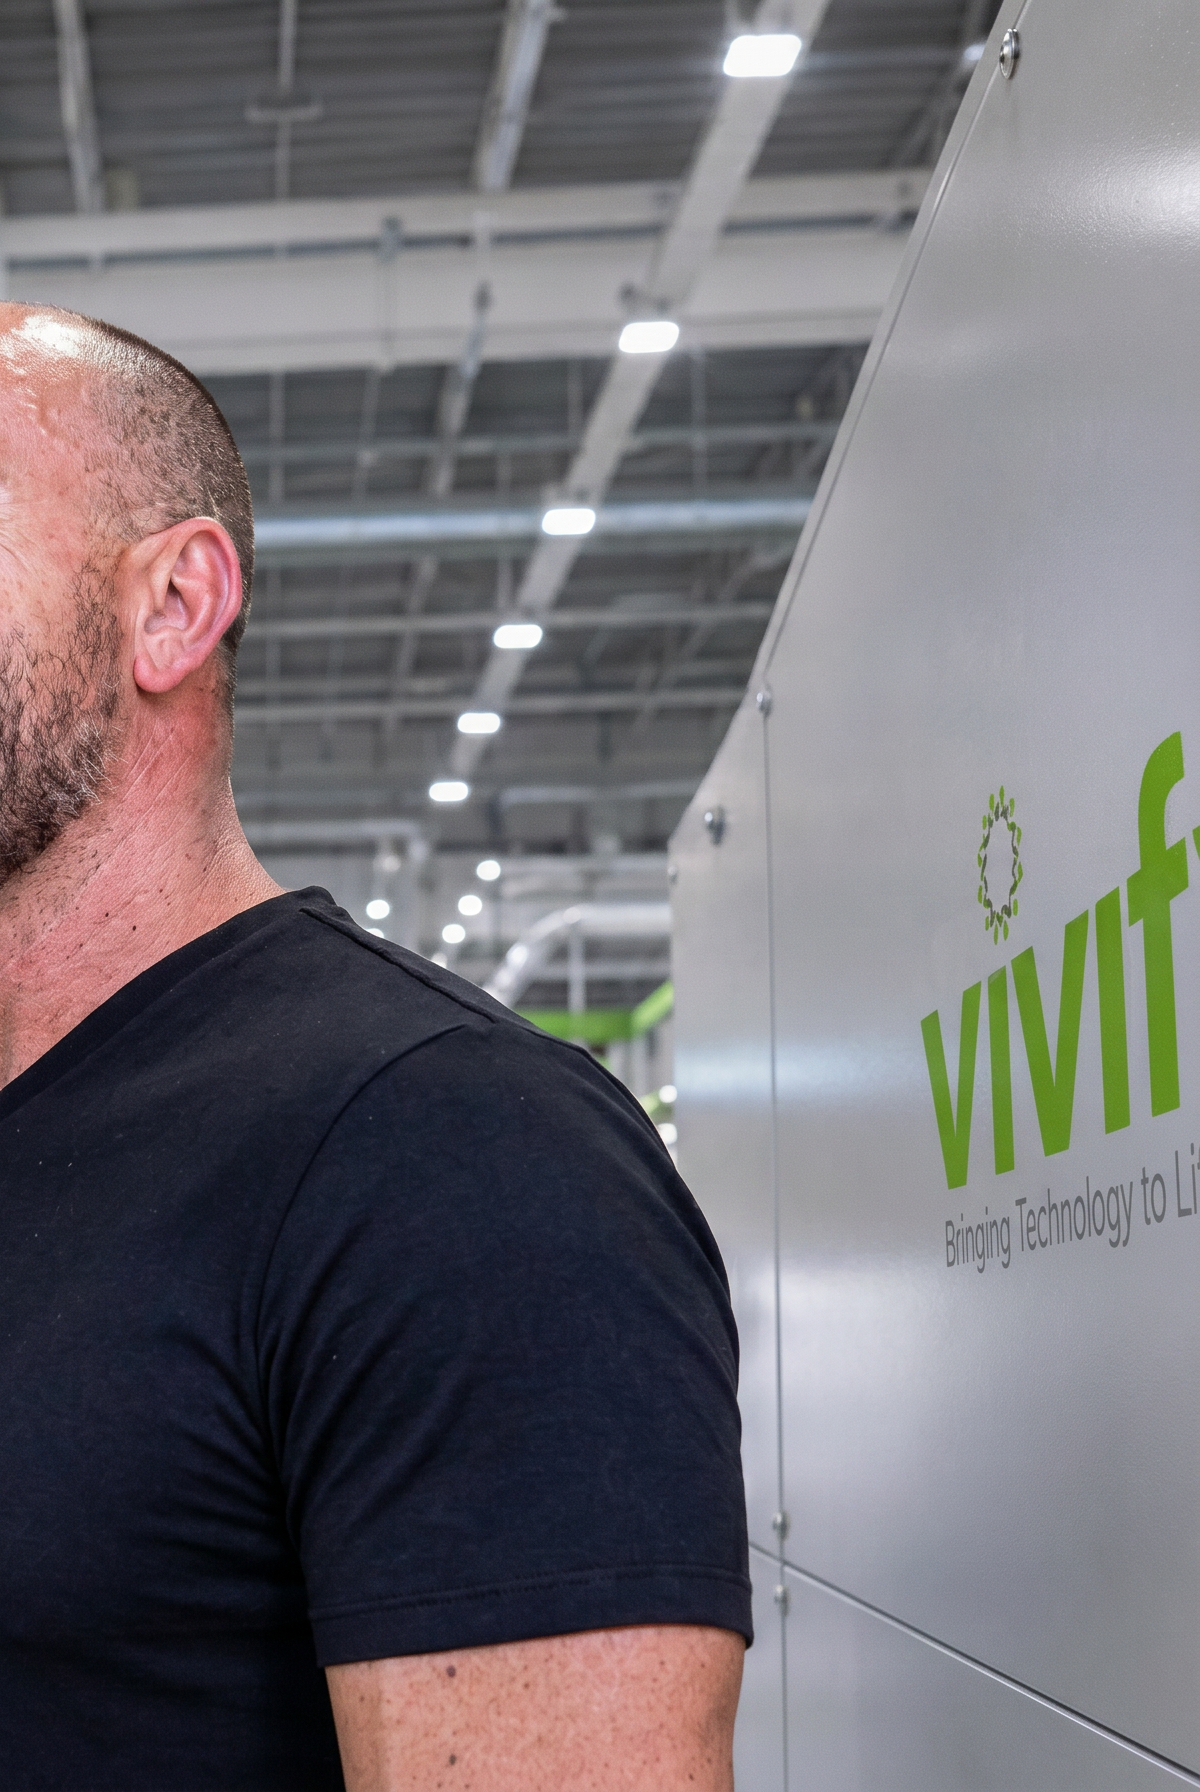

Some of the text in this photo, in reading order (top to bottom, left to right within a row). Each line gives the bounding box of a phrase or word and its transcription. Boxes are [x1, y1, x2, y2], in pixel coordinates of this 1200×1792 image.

[920, 731, 1200, 1190] vivif
[945, 1142, 1200, 1274] Bringing Technology to Li
